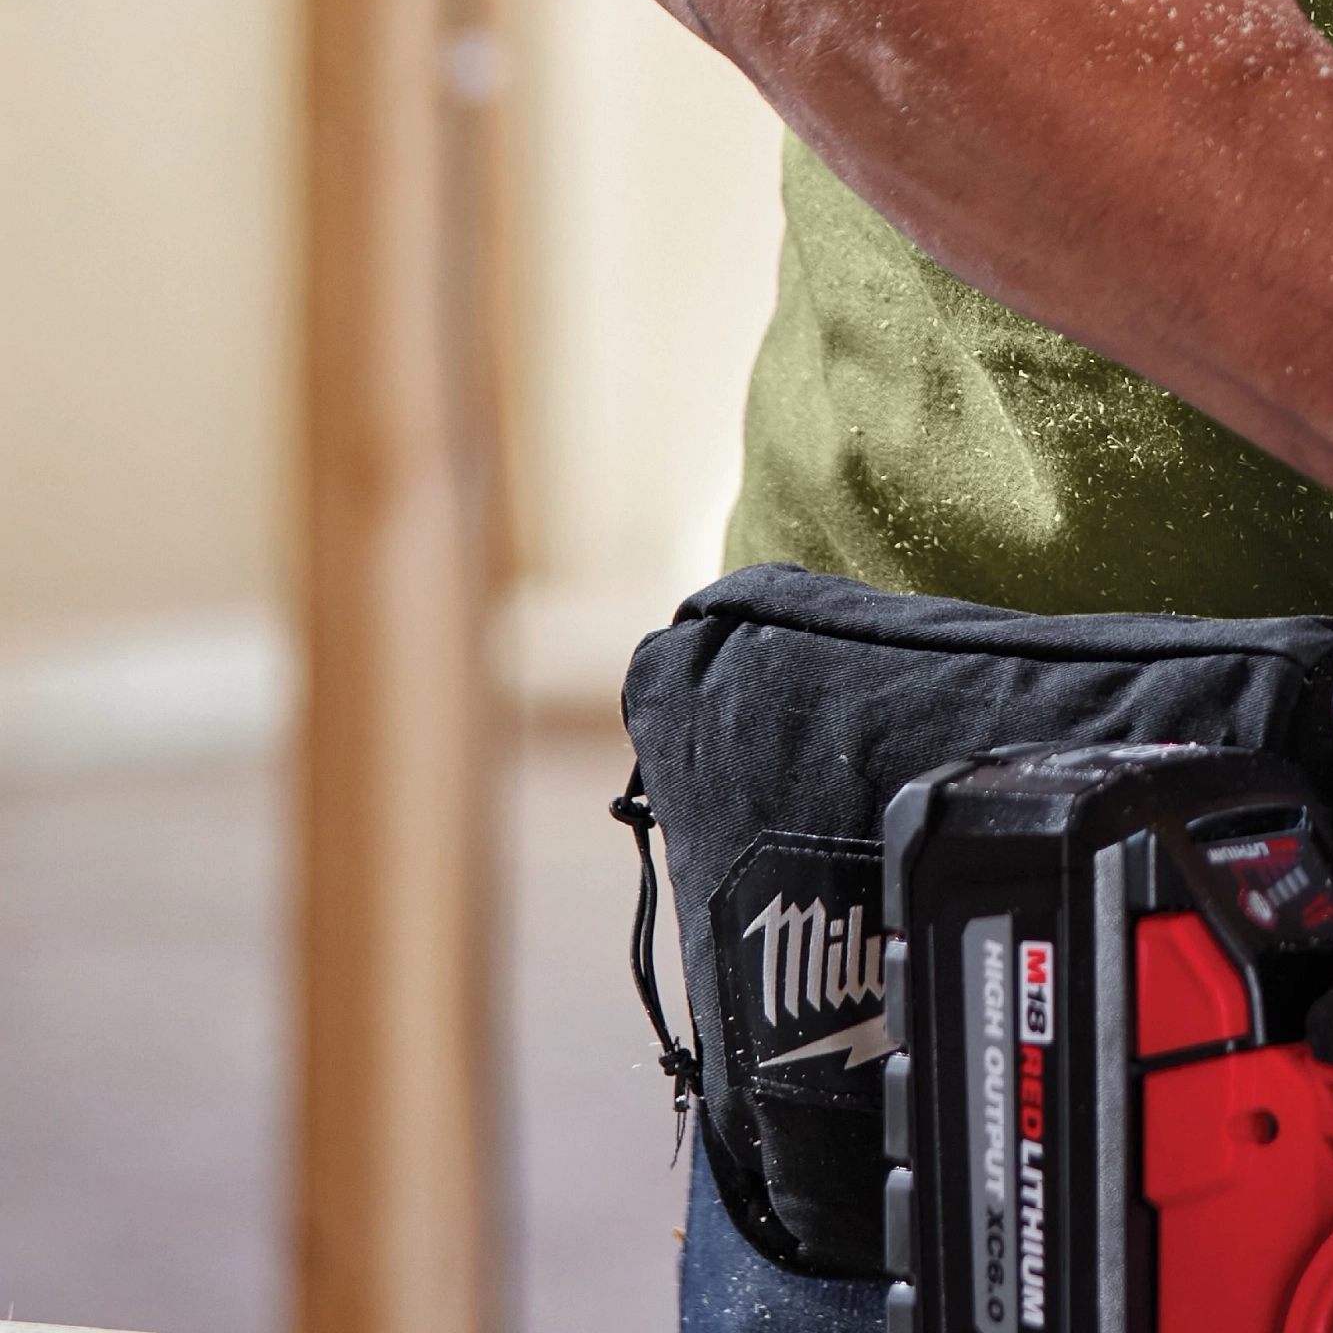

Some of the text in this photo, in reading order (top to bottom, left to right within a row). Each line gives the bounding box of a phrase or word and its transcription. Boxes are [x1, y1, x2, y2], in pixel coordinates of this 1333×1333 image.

[983, 939, 1005, 1040] HIGH
[1025, 946, 1048, 1036] M18
[984, 1045, 1006, 1202] OUTPUT
